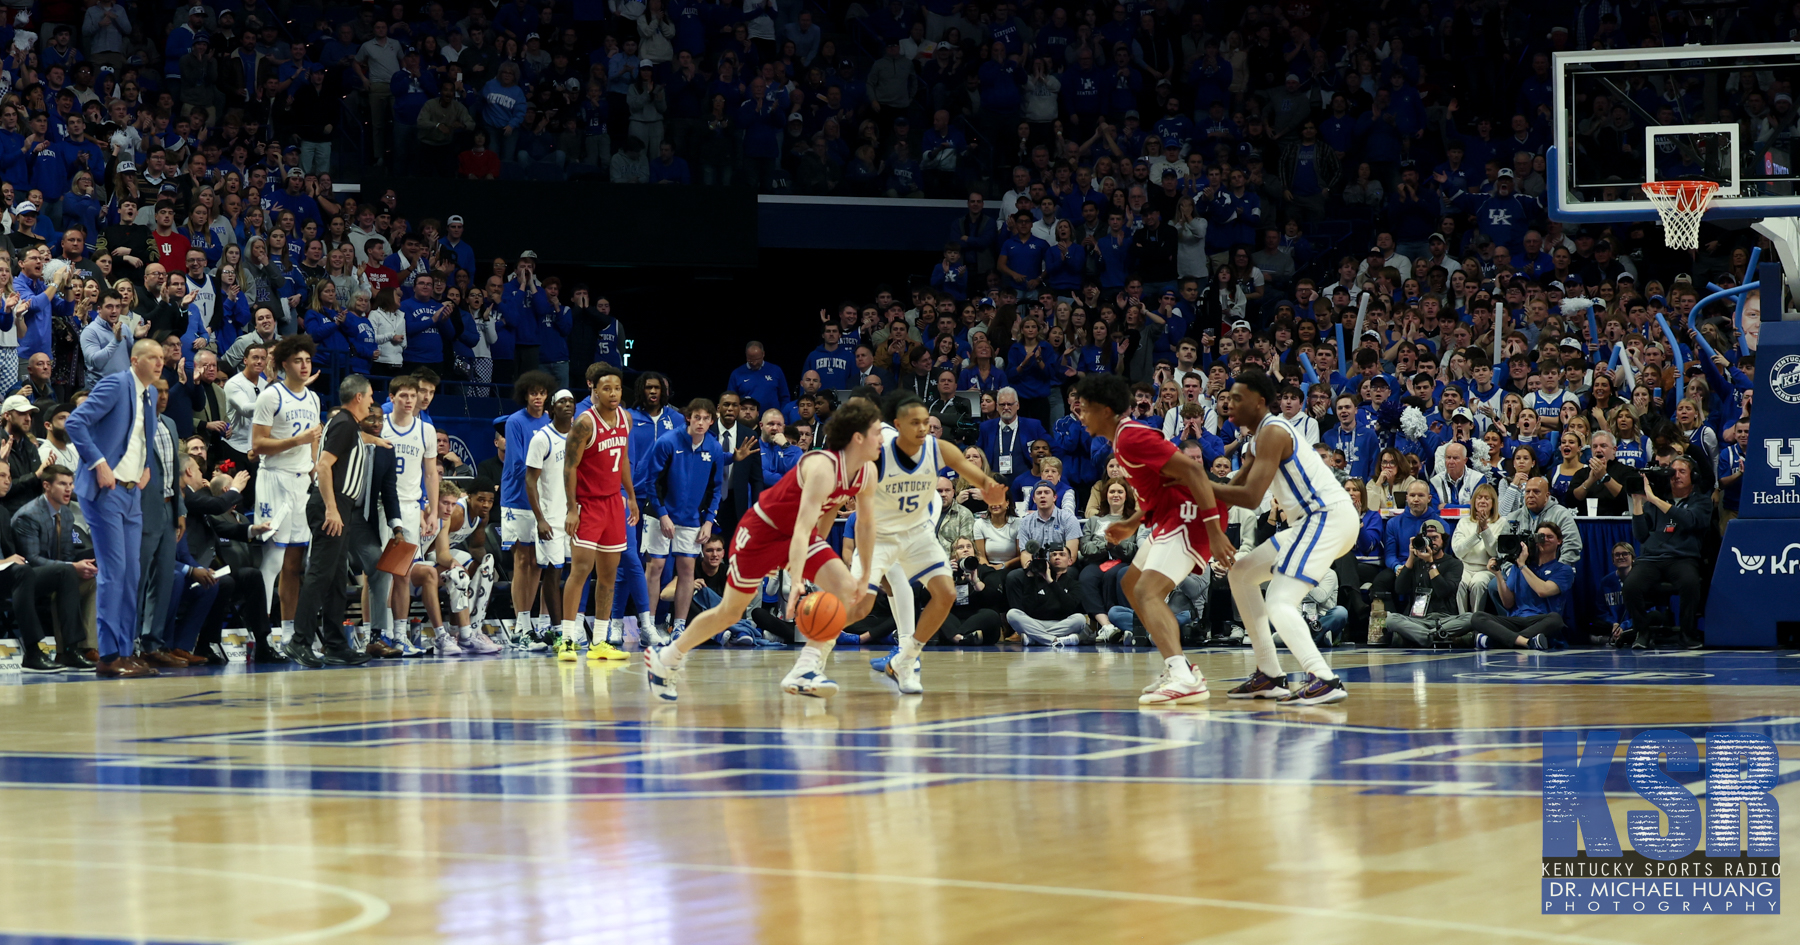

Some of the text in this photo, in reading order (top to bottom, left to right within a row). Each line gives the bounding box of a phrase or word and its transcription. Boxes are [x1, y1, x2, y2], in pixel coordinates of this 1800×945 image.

[994, 26, 1016, 38] KENTUCKY
[1488, 208, 1513, 226] UK
[161, 242, 172, 256] IU
[194, 292, 215, 304] ENTUCKY
[412, 307, 438, 319] KENTUC
[600, 333, 616, 343] TUCKY
[837, 337, 858, 347] NTUCKY
[597, 341, 611, 355] 15
[815, 357, 848, 371] KENTUCKY
[1774, 356, 1800, 372] KENTUC
[1783, 375, 1800, 387] KF
[1774, 386, 1791, 402] FARM
[285, 408, 318, 423] KENTUCKY
[1481, 417, 1487, 432] 1
[394, 444, 421, 462] TUCKY
[1616, 450, 1644, 459] ENTUCKY
[609, 448, 622, 474] 7
[885, 480, 933, 495] KENTUCKY
[898, 494, 920, 514] 15
[1752, 489, 1800, 504] Health
[258, 501, 273, 518] UK
[1179, 500, 1199, 523] IU
[1770, 542, 1800, 575] Kr
[1604, 591, 1625, 607] KENT
